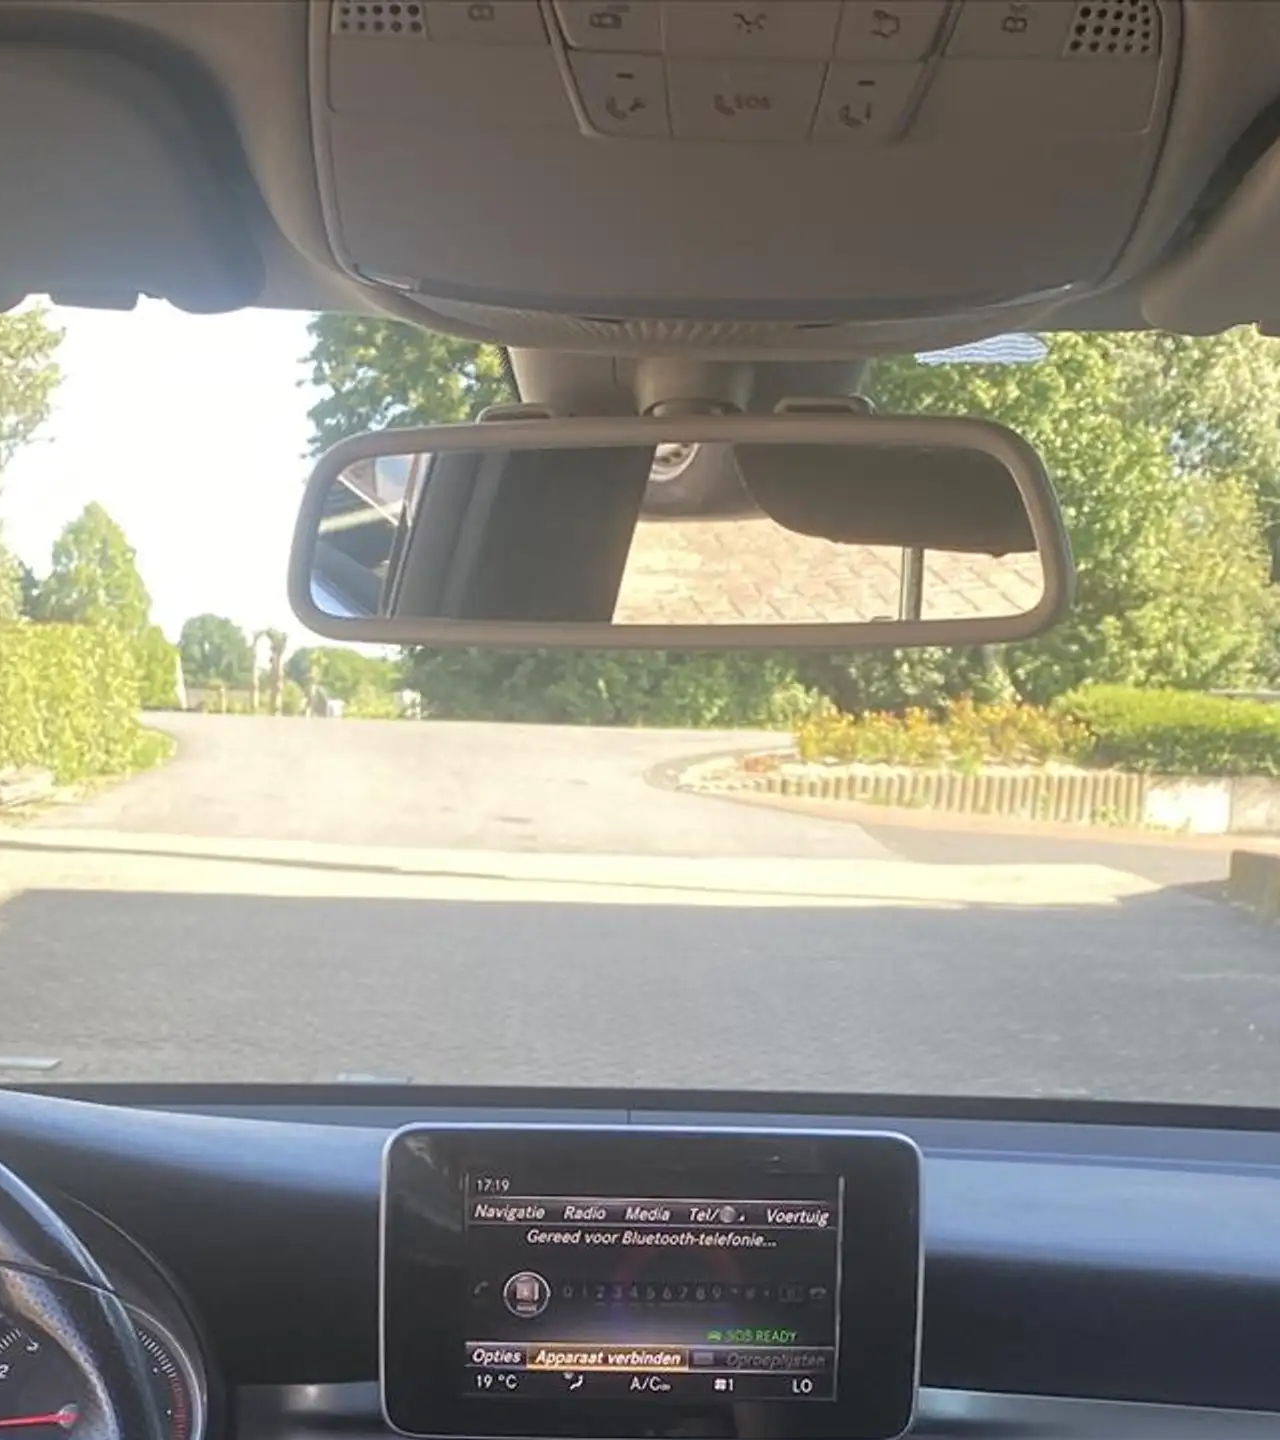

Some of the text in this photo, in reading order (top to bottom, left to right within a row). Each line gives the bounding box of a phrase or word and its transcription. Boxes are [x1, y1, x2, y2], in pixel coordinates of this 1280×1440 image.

[474, 1203, 546, 1222] Navigatie
[563, 1205, 607, 1220] Radio
[624, 1206, 670, 1221] Media
[766, 1208, 830, 1227] Voertuig
[527, 1229, 581, 1244] Gereed
[585, 1232, 620, 1245] voor
[756, 1331, 797, 1343] READY
[473, 1349, 521, 1365] Opties
[536, 1350, 603, 1367] Apparaat
[608, 1352, 681, 1366] verbinden
[476, 1374, 493, 1388] 19
[498, 1374, 519, 1389] °C
[792, 1379, 814, 1393] LO
